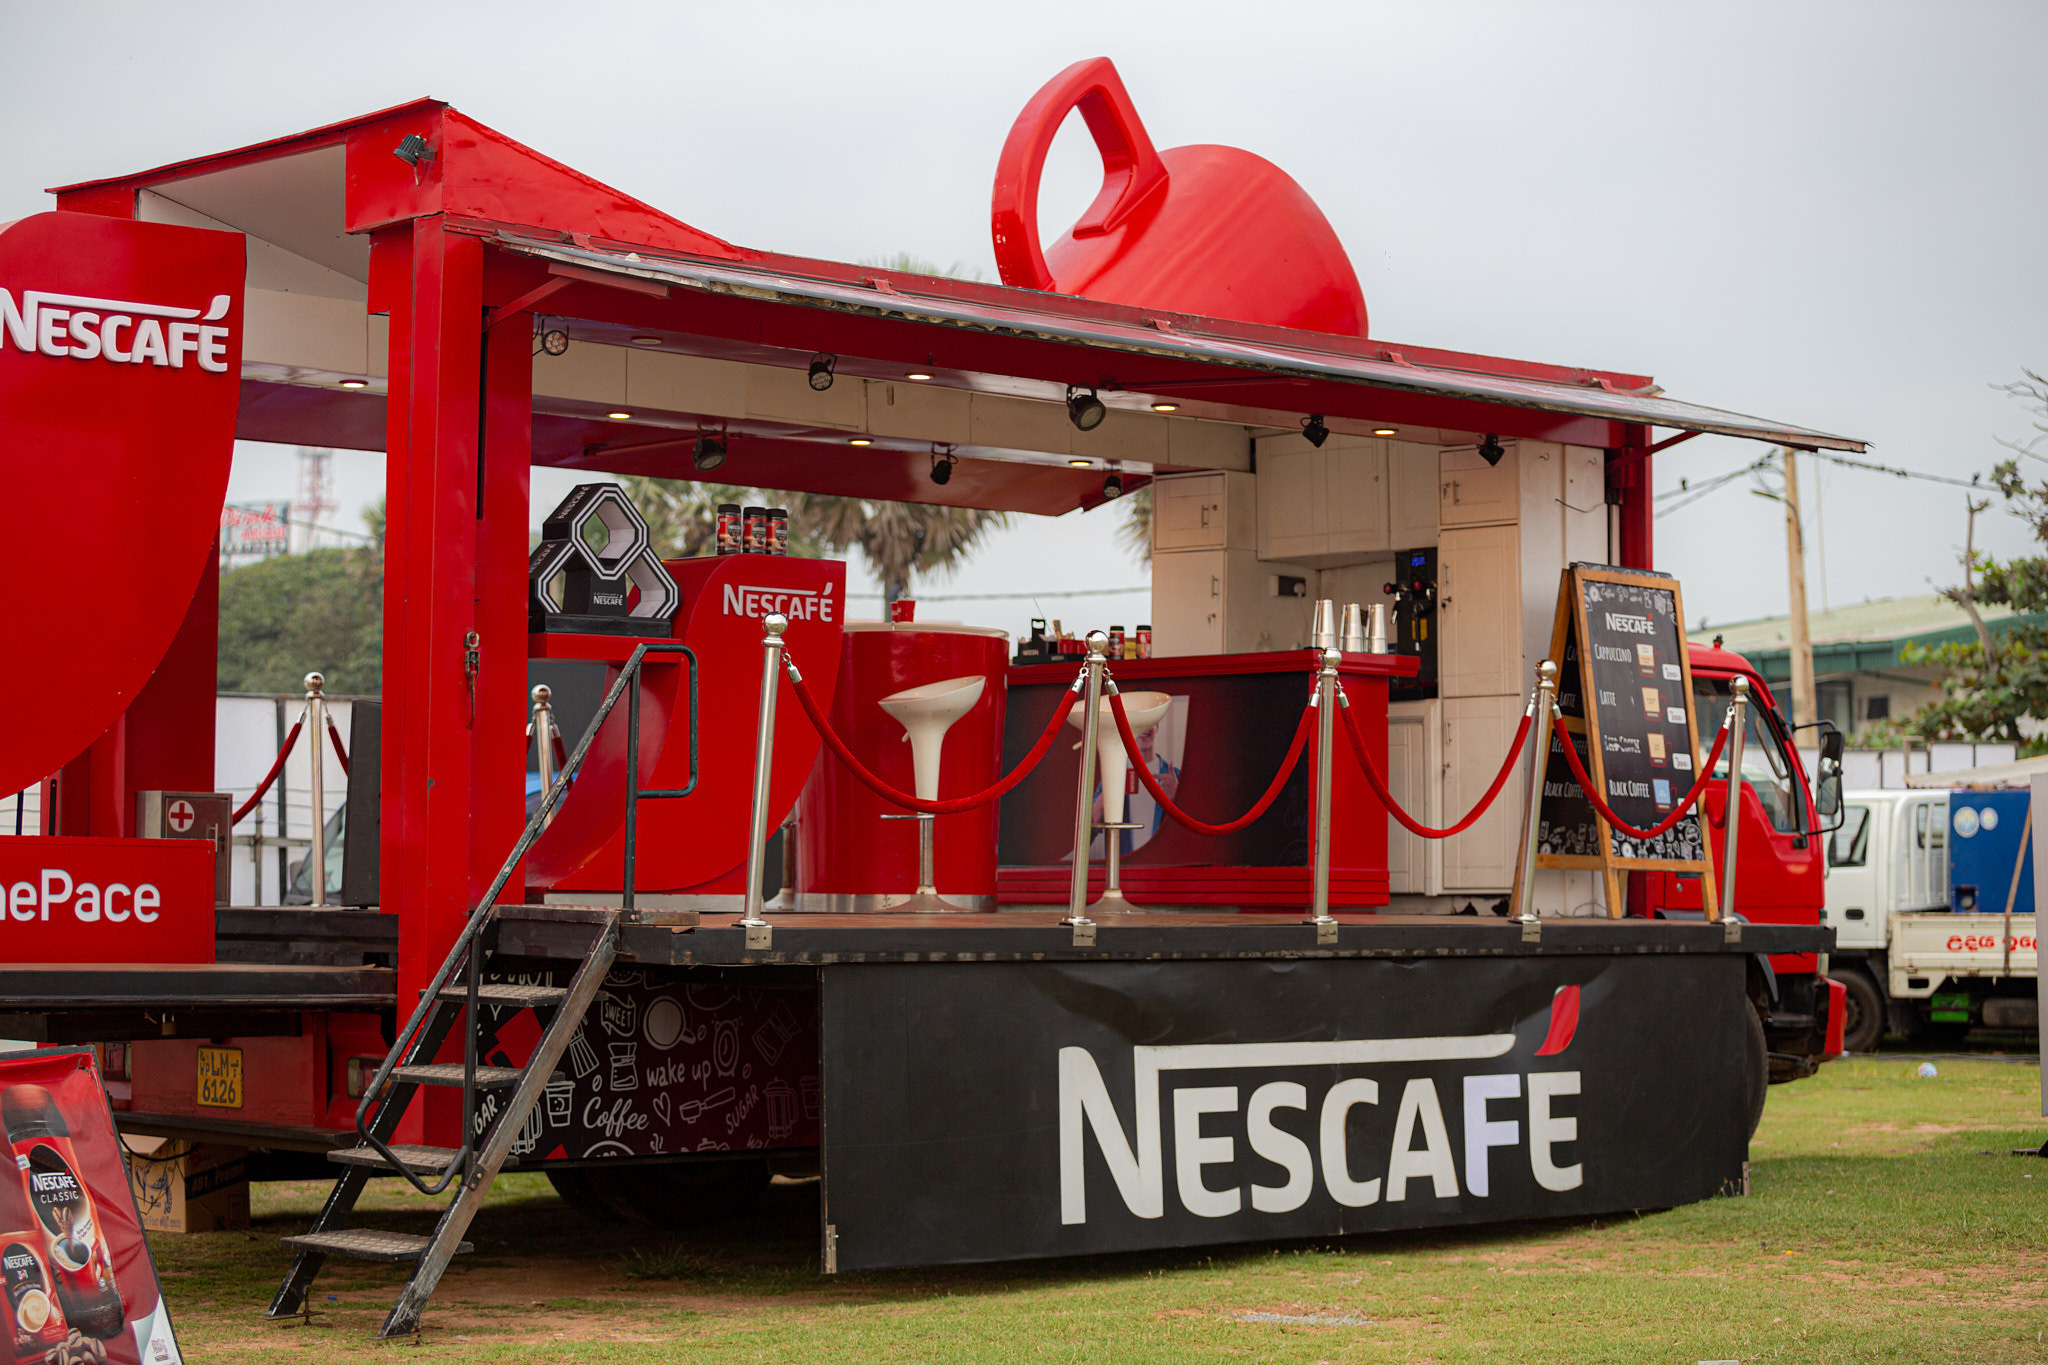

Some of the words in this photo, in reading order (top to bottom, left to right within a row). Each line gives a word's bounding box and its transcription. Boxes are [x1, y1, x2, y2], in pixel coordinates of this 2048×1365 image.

[0, 287, 231, 373] NESCAFÉ
[723, 582, 833, 622] NESCAFÉ
[1605, 612, 1655, 635] NESCAFÉ
[1594, 643, 1632, 663] CAPPUCCINO
[1600, 689, 1616, 706] LATTE
[1609, 779, 1629, 797] BLACK
[1628, 780, 1650, 798] COFFEE
[604, 1001, 632, 1028] SWEET
[647, 1057, 685, 1088] wake
[692, 1060, 711, 1091] up
[203, 1079, 236, 1103] 6126
[583, 1096, 649, 1138] Coffee
[726, 1084, 760, 1135] SUGAR
[1058, 984, 1584, 1226] NESCAFÉ
[40, 1190, 79, 1204] CLASSIC
